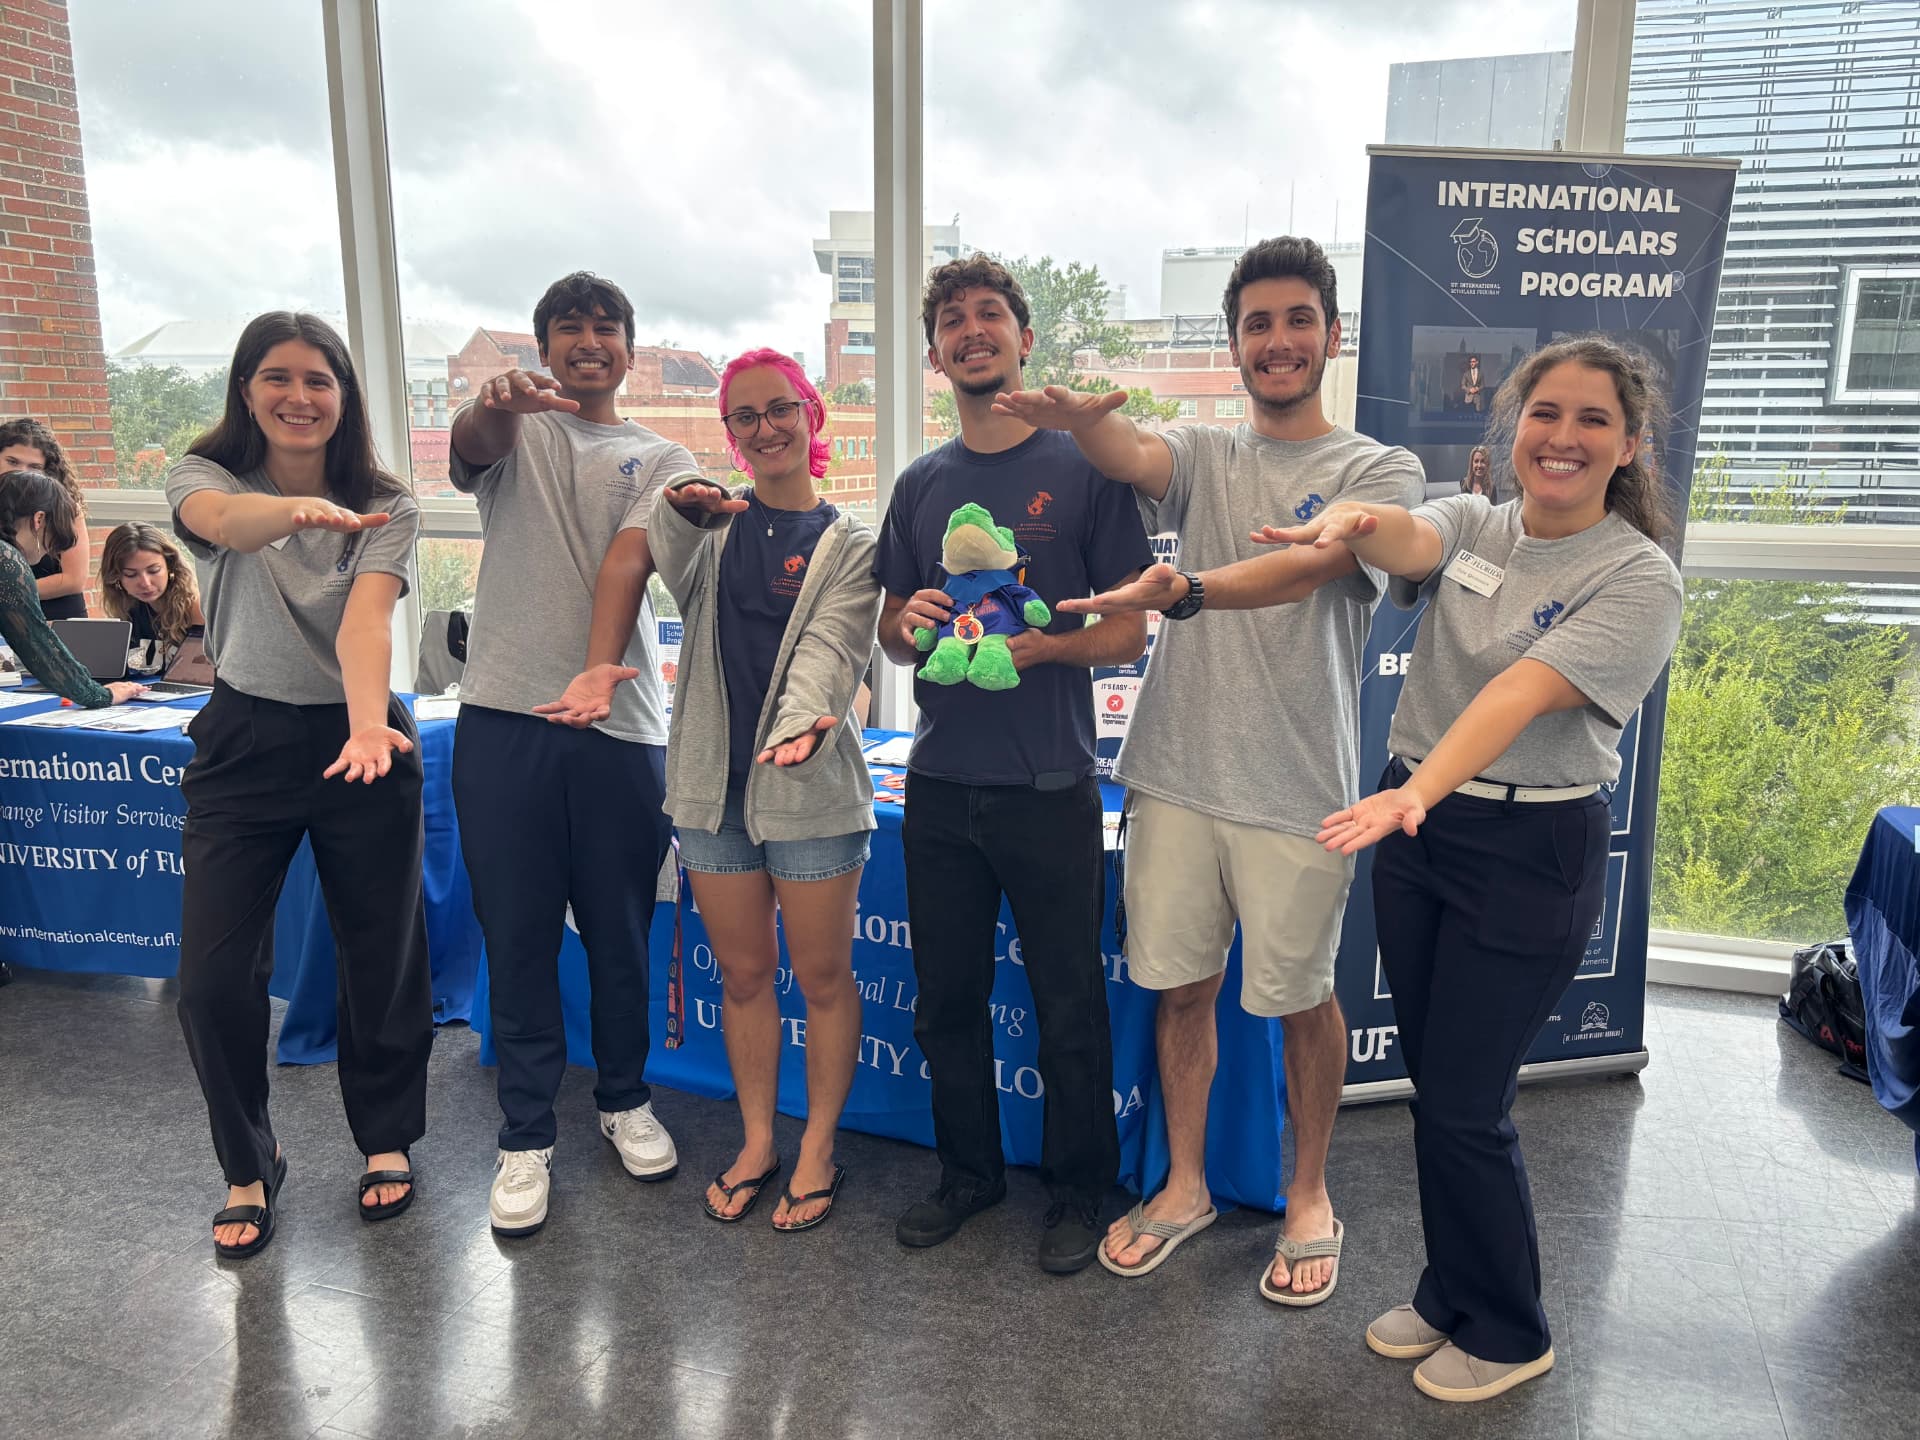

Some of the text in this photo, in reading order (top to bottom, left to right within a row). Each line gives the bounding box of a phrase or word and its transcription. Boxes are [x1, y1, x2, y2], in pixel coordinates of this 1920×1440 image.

[1438, 180, 1681, 214] INTERNATIONAL
[1516, 228, 1678, 256] SCHOLARS
[1519, 271, 1673, 298] PROGRAM
[1460, 551, 1474, 562] UF
[0, 752, 133, 782] ernational
[50, 802, 109, 825] Visitor
[117, 804, 188, 831] Services
[126, 848, 149, 879] of
[1350, 1025, 1398, 1063] UF
